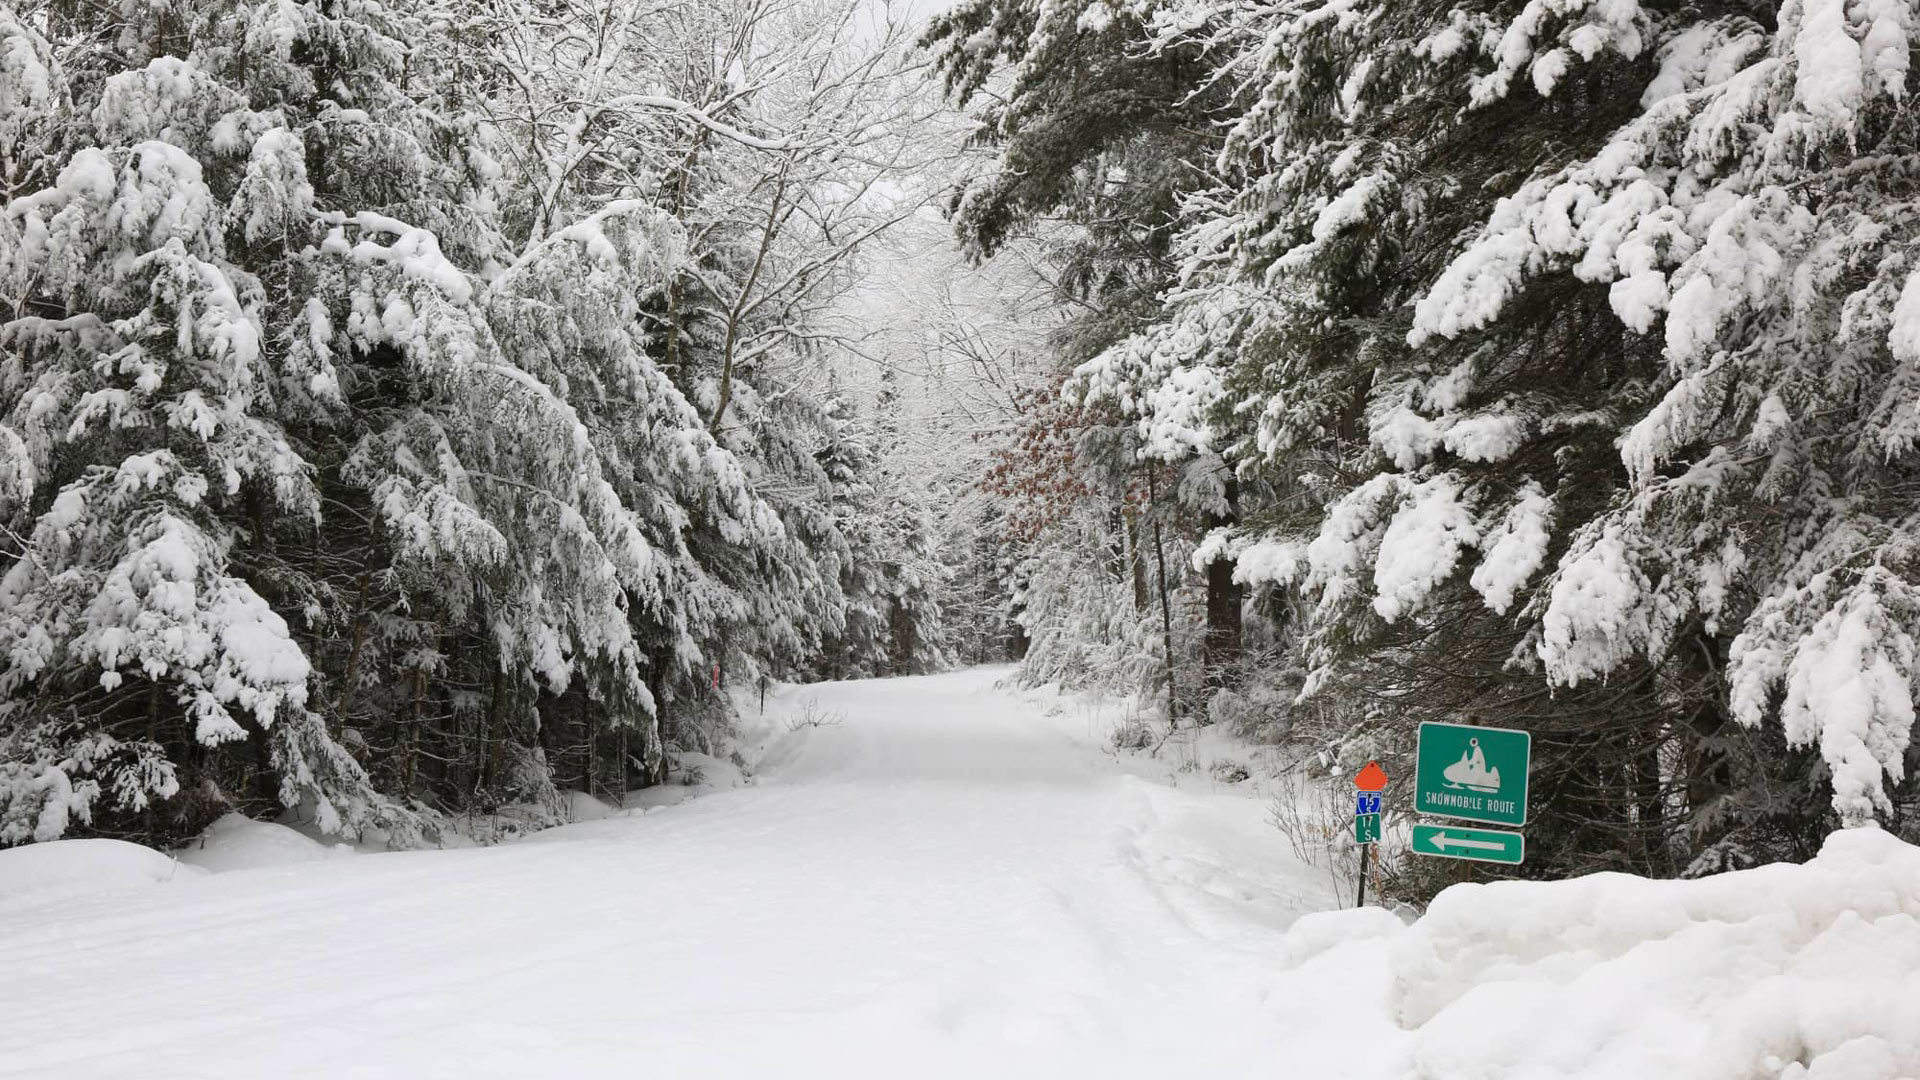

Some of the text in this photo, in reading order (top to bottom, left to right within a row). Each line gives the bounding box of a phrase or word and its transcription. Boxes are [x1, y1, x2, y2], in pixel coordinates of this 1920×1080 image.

[1365, 797, 1374, 806] 15
[1425, 791, 1515, 814] SNOWMOBILE ROUTE
[1362, 815, 1373, 828] 17
[1364, 829, 1371, 841] S
